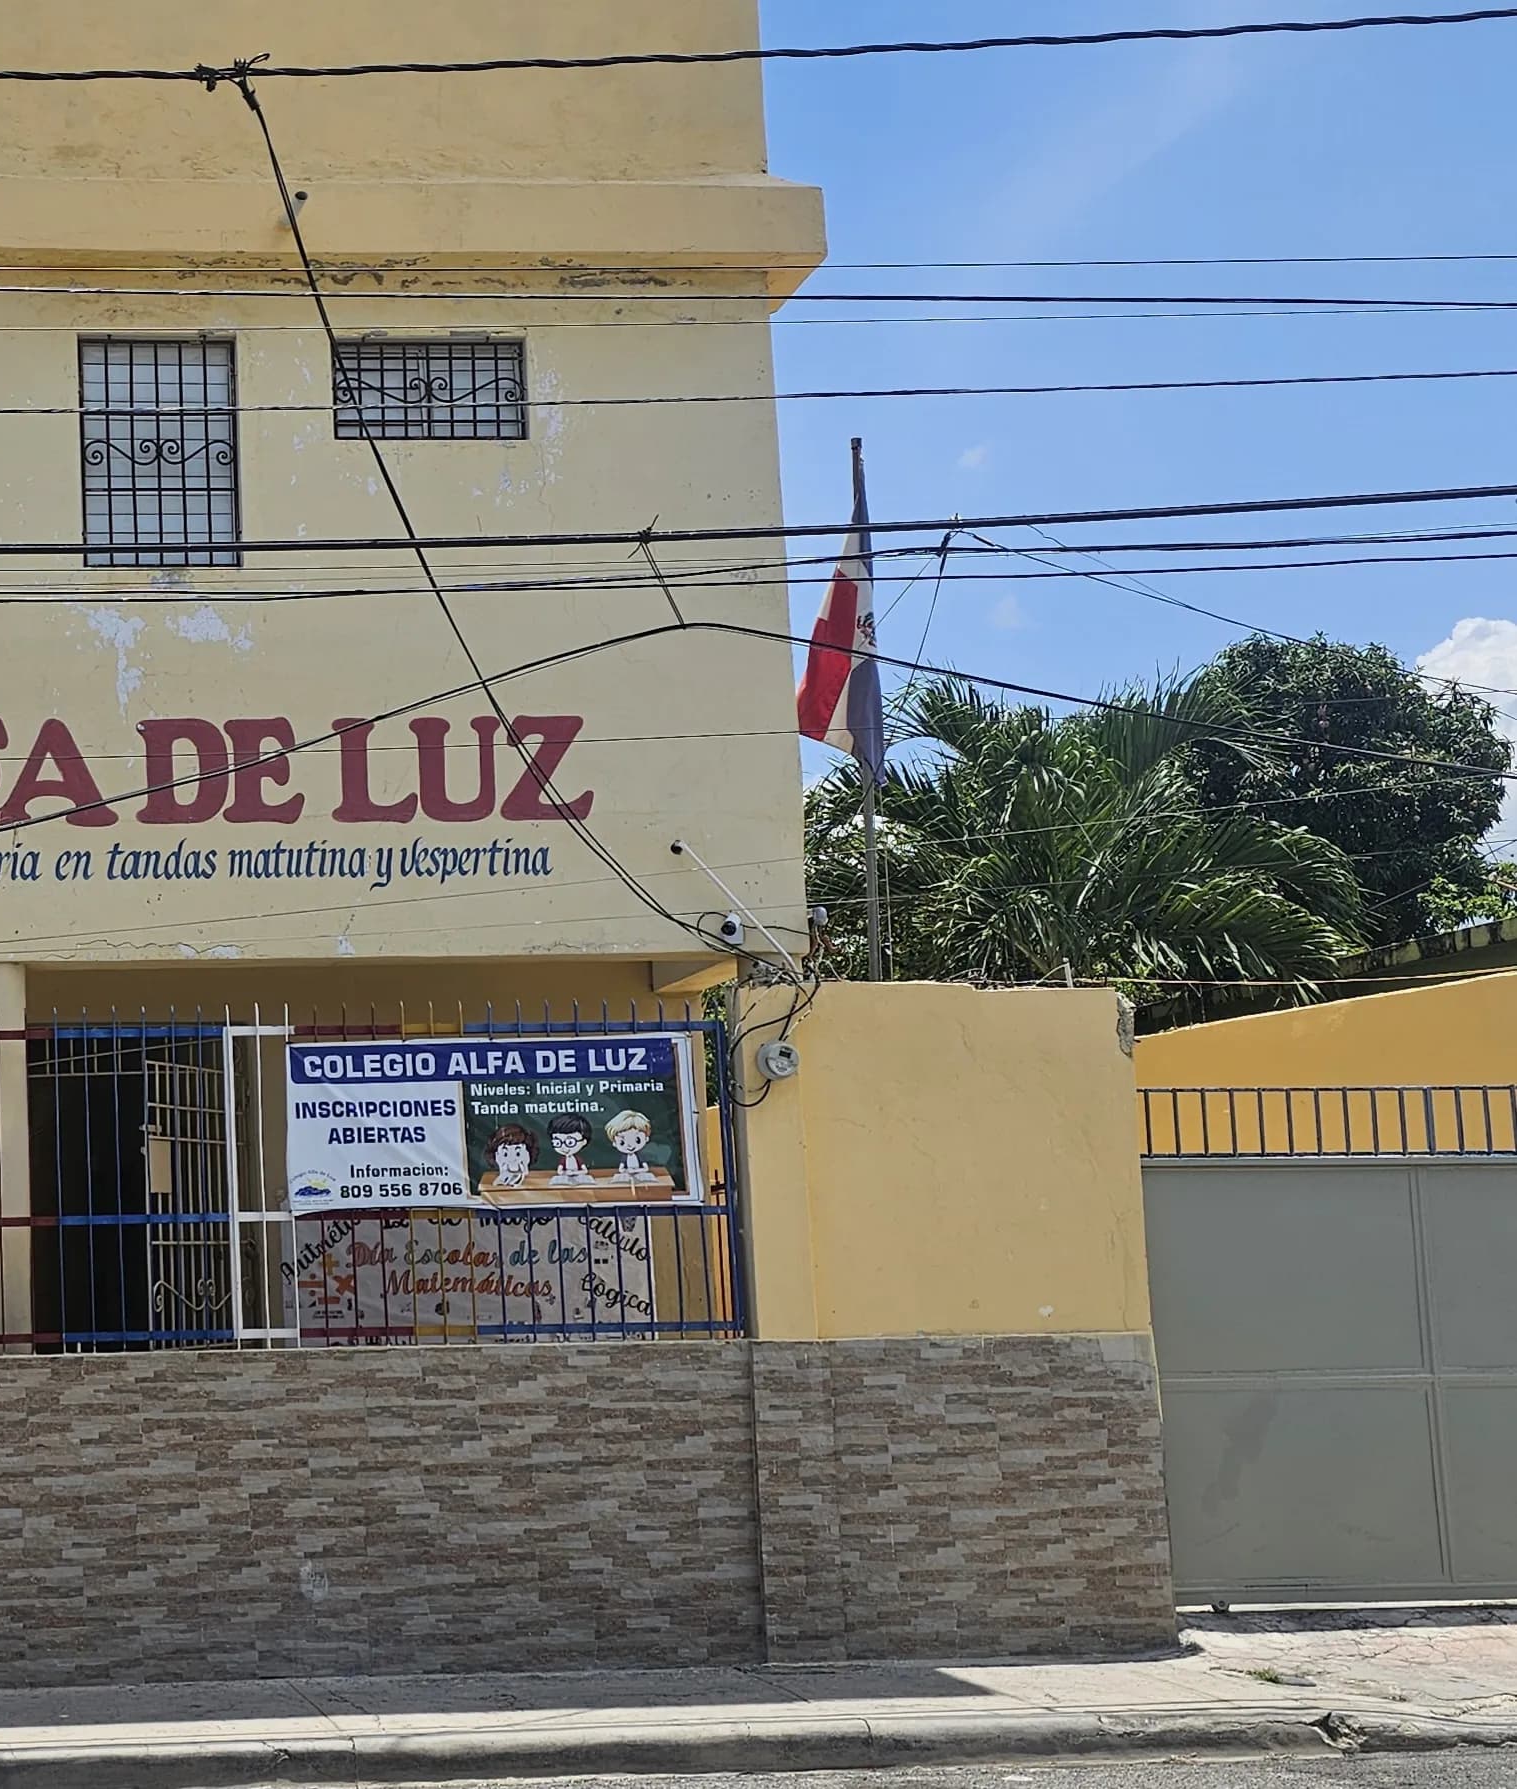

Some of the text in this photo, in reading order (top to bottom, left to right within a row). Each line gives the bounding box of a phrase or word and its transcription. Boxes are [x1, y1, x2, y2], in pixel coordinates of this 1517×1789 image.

[135, 717, 306, 824] DE
[331, 715, 595, 822] LUZ
[54, 849, 93, 881] en
[106, 839, 218, 881] tandas
[228, 840, 367, 880] matutina
[370, 846, 393, 891] y
[303, 1047, 648, 1079] COLEGIO ALFA DE LUZ
[470, 1079, 665, 1097] Niveles: Inicial y Primaria
[295, 1099, 456, 1119] INSCRIPCIONES
[471, 1099, 605, 1115] Tanda matutina.
[328, 1126, 426, 1145] ABIERTAS
[350, 1164, 449, 1178] Informacion:
[340, 1182, 463, 1199] 809 556 8706
[345, 1241, 397, 1269] Día
[509, 1239, 540, 1267] de
[548, 1239, 588, 1264] las
[380, 1269, 553, 1299] Matemáticas
